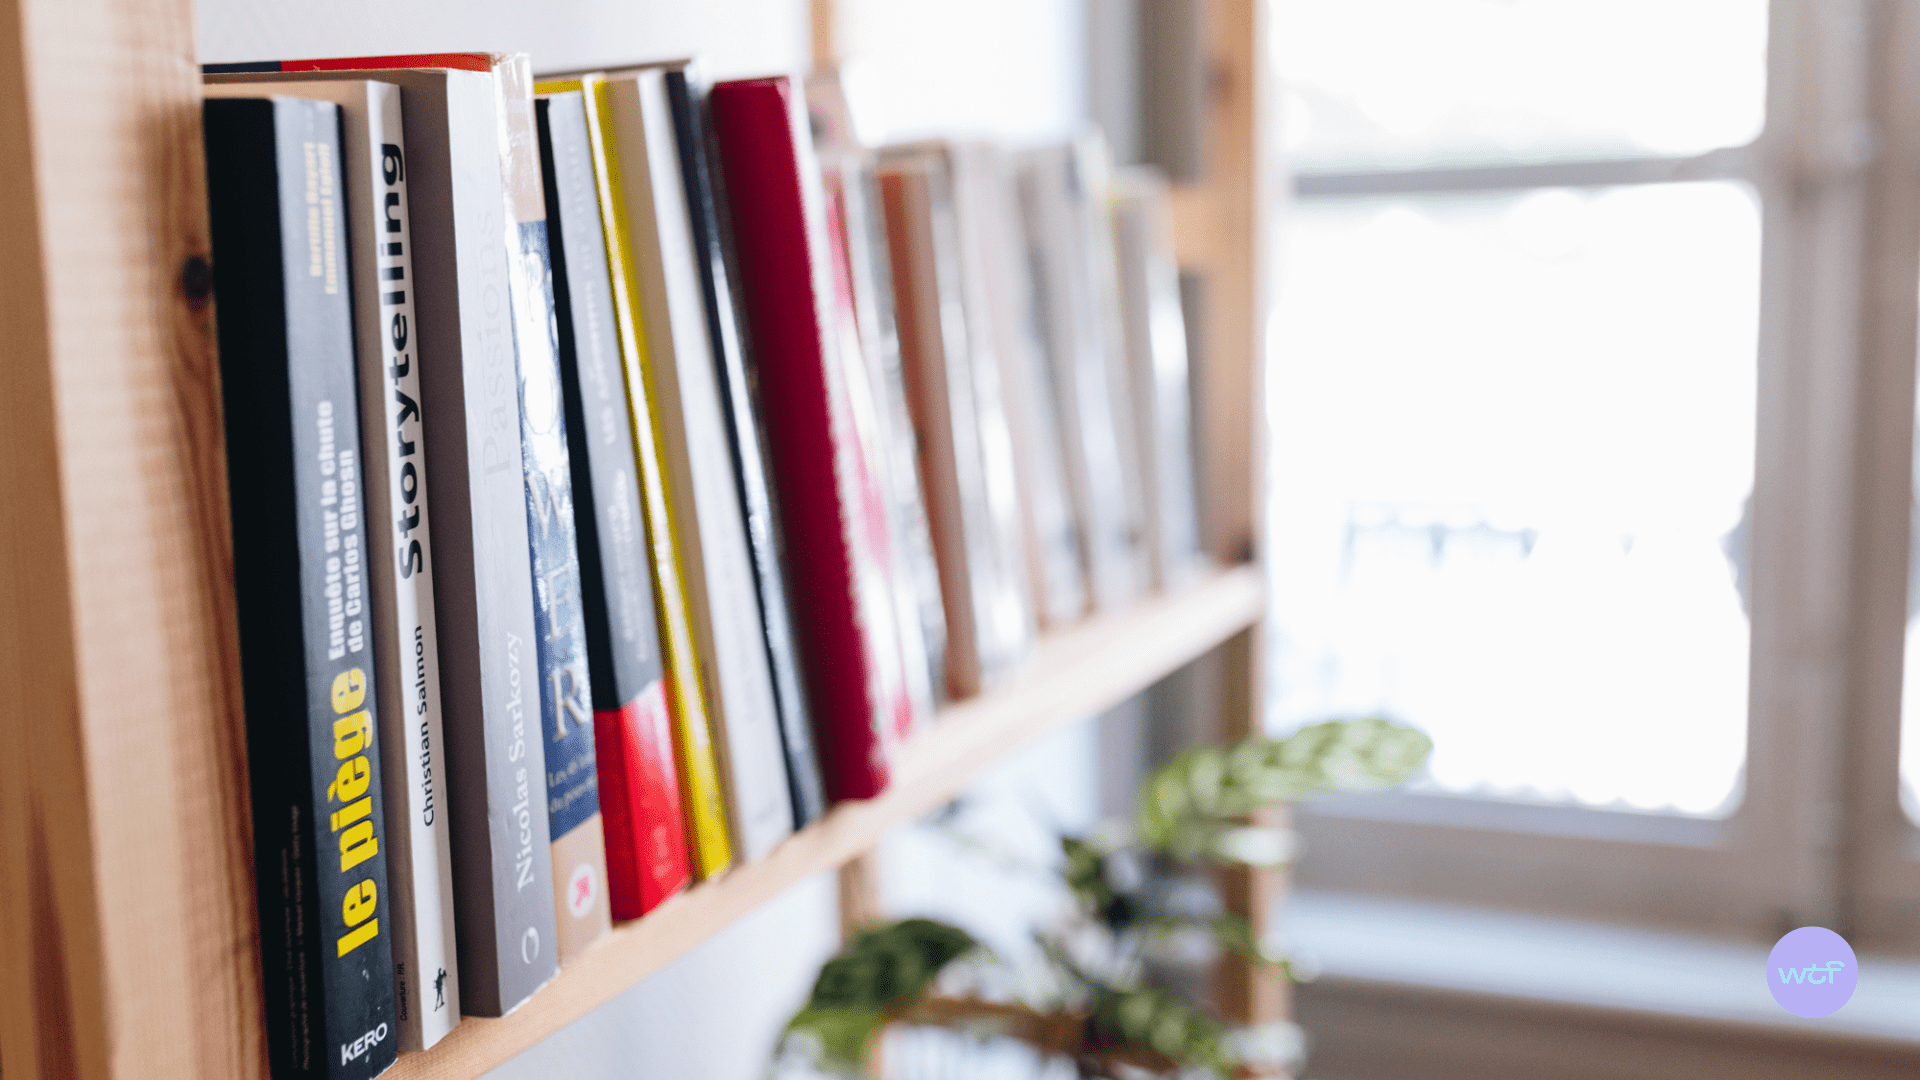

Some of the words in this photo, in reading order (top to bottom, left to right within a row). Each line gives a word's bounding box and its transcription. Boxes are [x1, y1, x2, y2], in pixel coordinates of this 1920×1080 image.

[380, 143, 423, 580] Storytelling
[477, 211, 511, 484] Passions
[317, 401, 337, 477] chute
[320, 479, 338, 507] la
[324, 509, 341, 553] sur
[339, 449, 358, 531] Ghosn
[324, 556, 346, 662] Enquête
[343, 533, 363, 617] Carlos
[347, 619, 364, 653] de
[414, 625, 428, 716] Salmon
[505, 632, 526, 763] Sarkozy
[327, 667, 379, 873] piège
[419, 721, 435, 827] Christian
[512, 767, 535, 893] Nicolas
[336, 878, 379, 958] le
[399, 981, 408, 1021] Couverture
[341, 1022, 388, 1067] KERO
